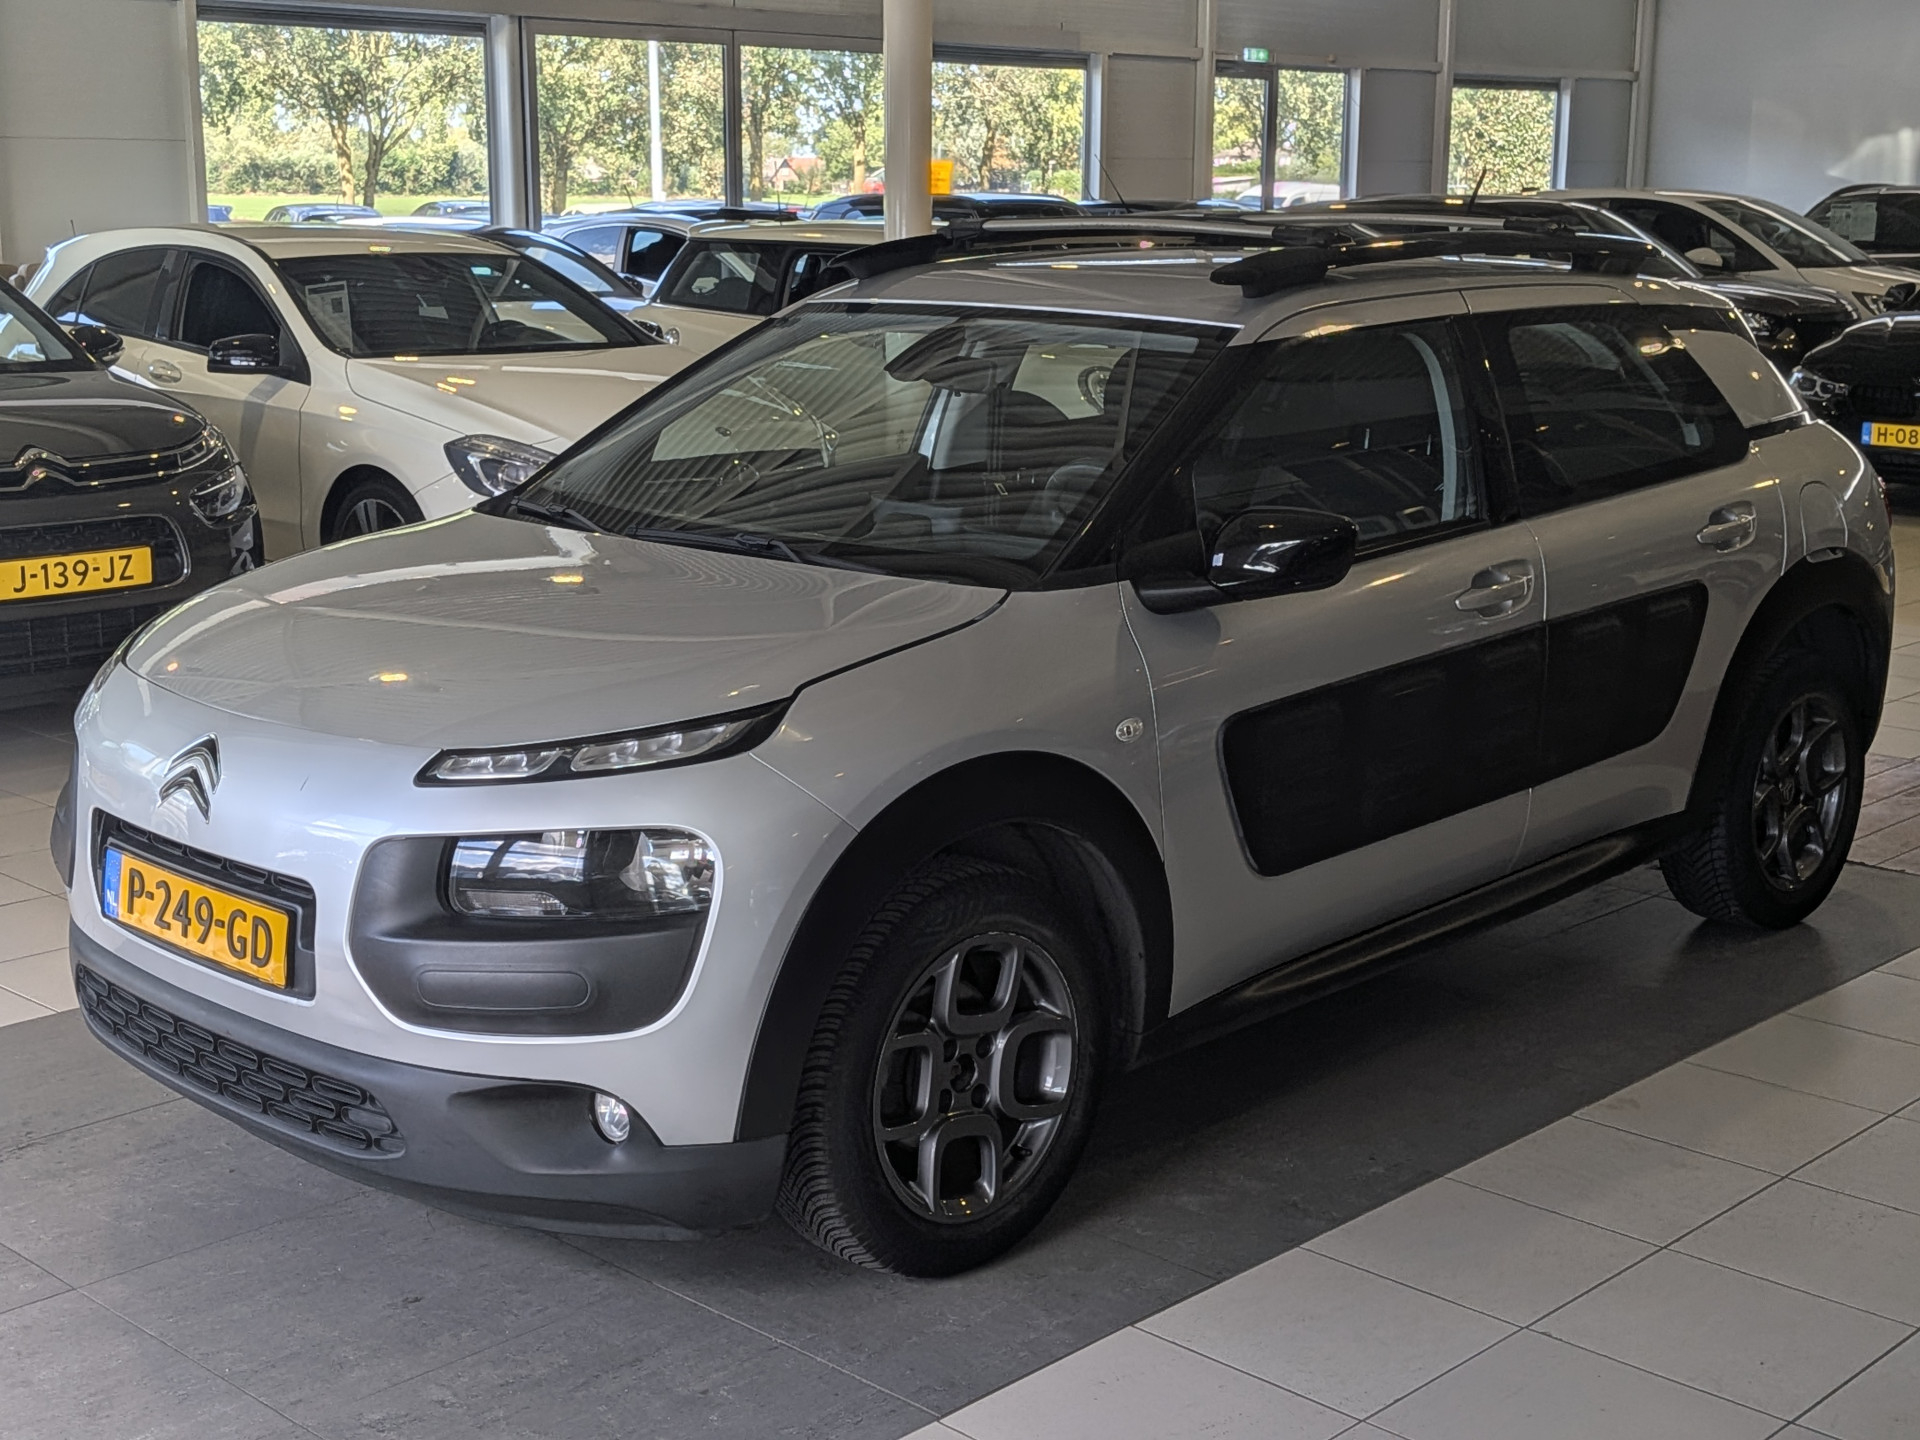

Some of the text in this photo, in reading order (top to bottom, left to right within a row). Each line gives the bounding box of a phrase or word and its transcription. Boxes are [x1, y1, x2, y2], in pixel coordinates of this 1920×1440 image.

[12, 554, 135, 593] J-139-JZ
[106, 889, 118, 907] NL
[127, 867, 273, 968] P-249-GD
